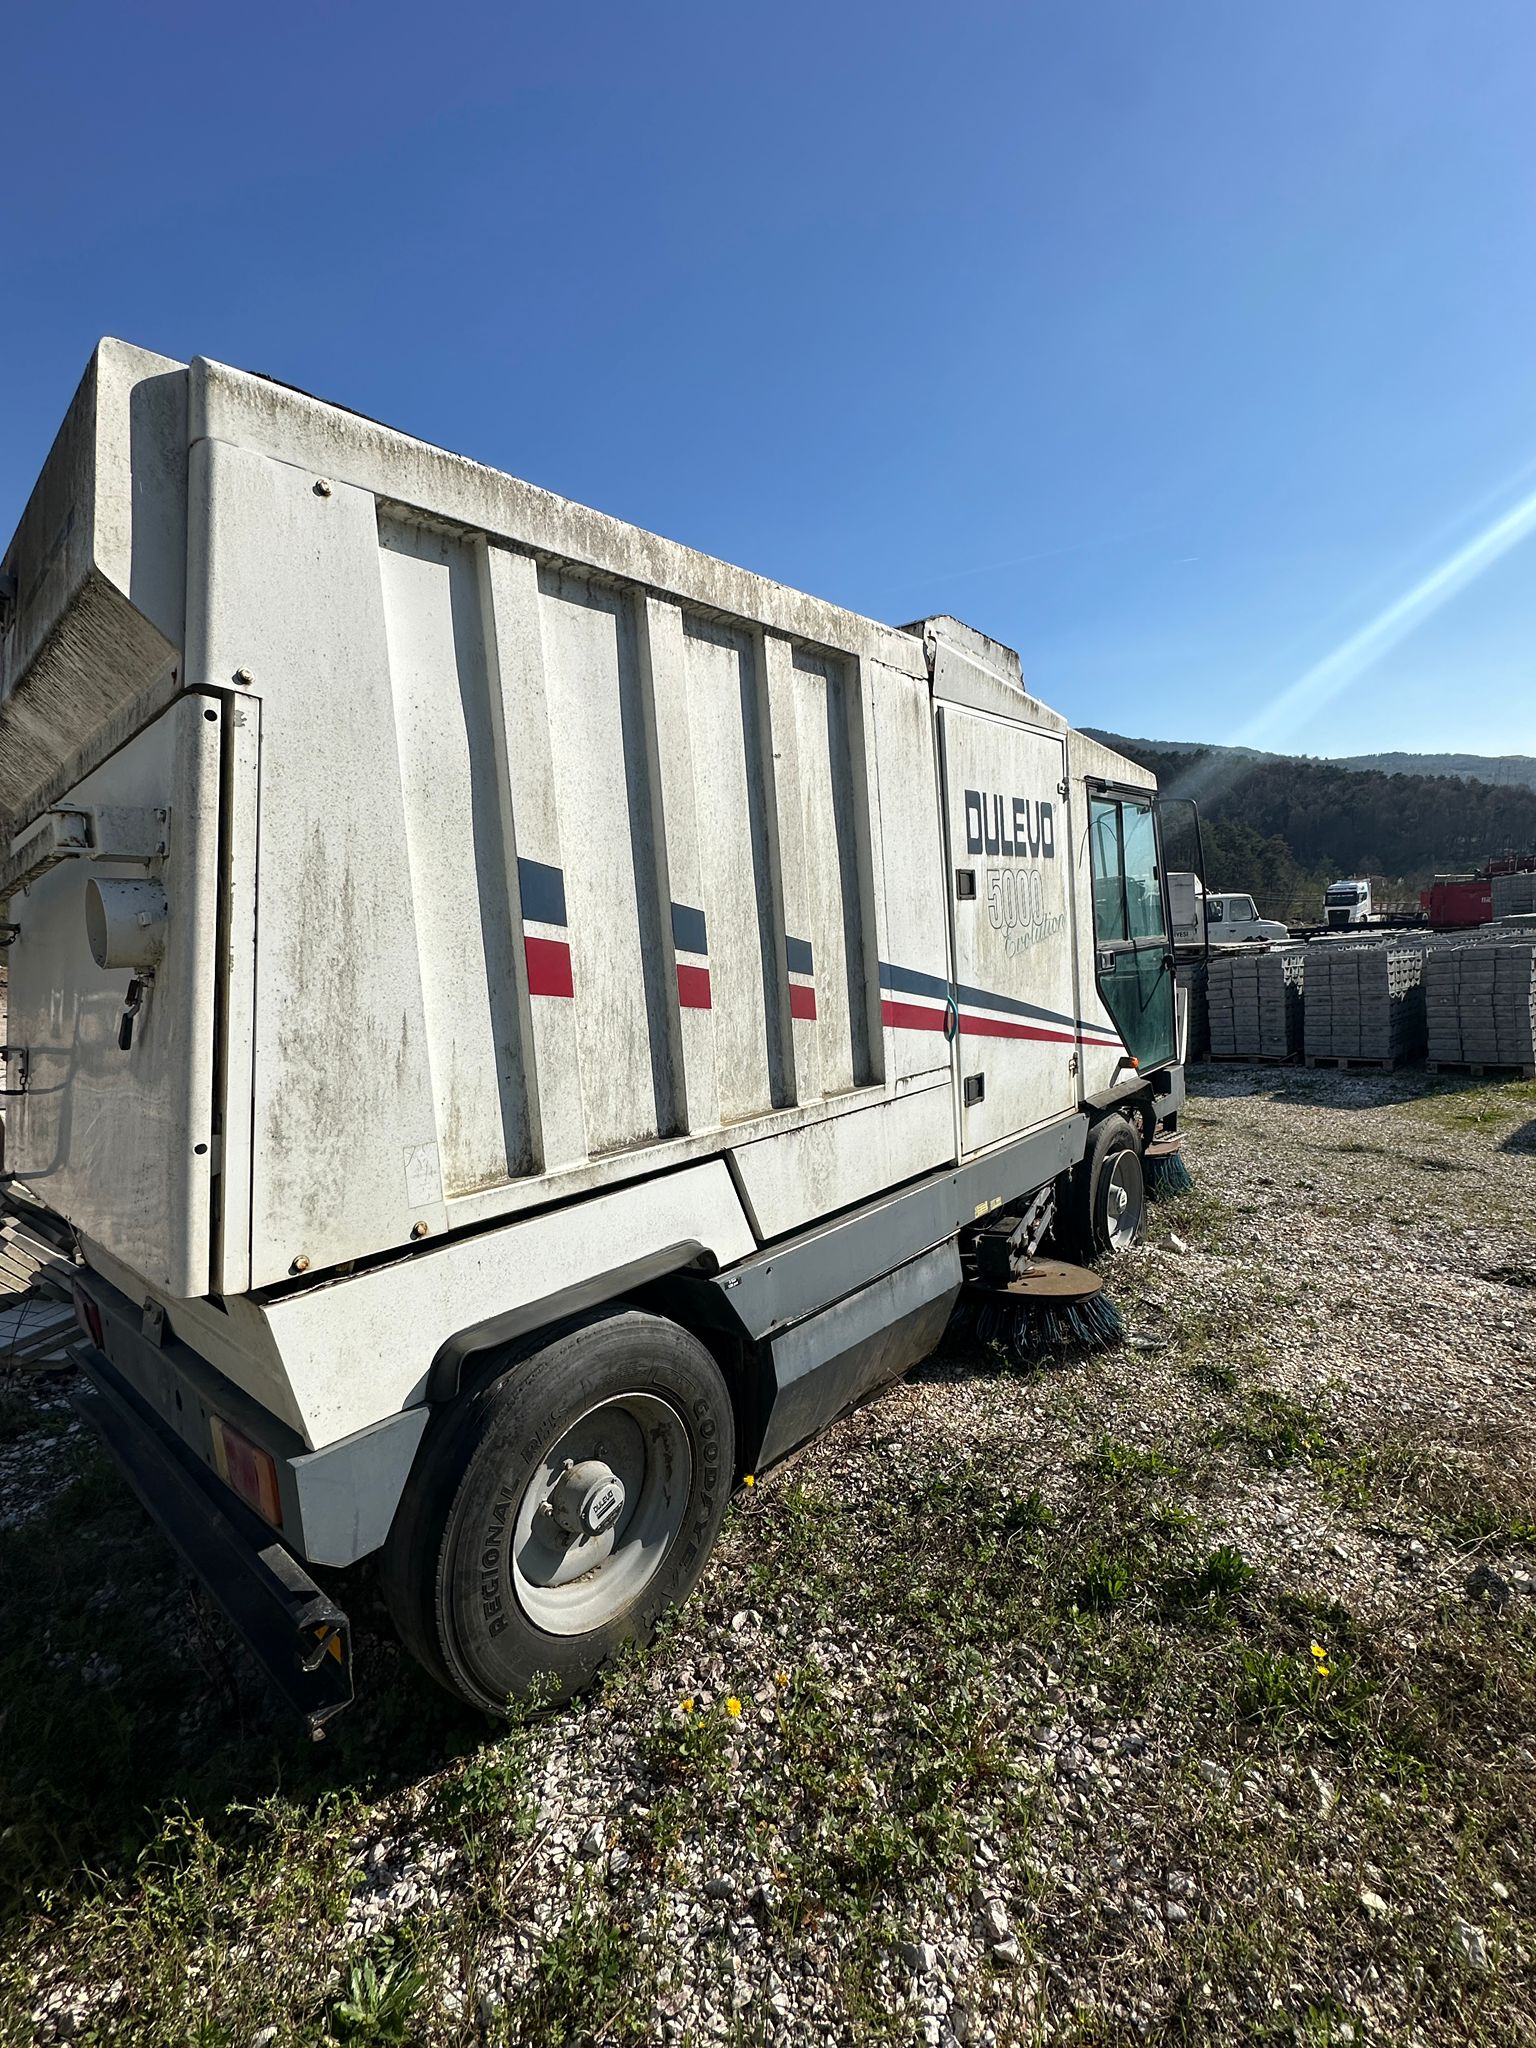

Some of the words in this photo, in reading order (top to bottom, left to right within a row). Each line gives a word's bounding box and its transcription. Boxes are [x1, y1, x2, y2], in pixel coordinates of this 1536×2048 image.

[965, 789, 1055, 858] DULEVO
[986, 868, 1045, 930] 5000
[1001, 911, 1066, 959] Evolution
[481, 1477, 521, 1639] REGIONAL
